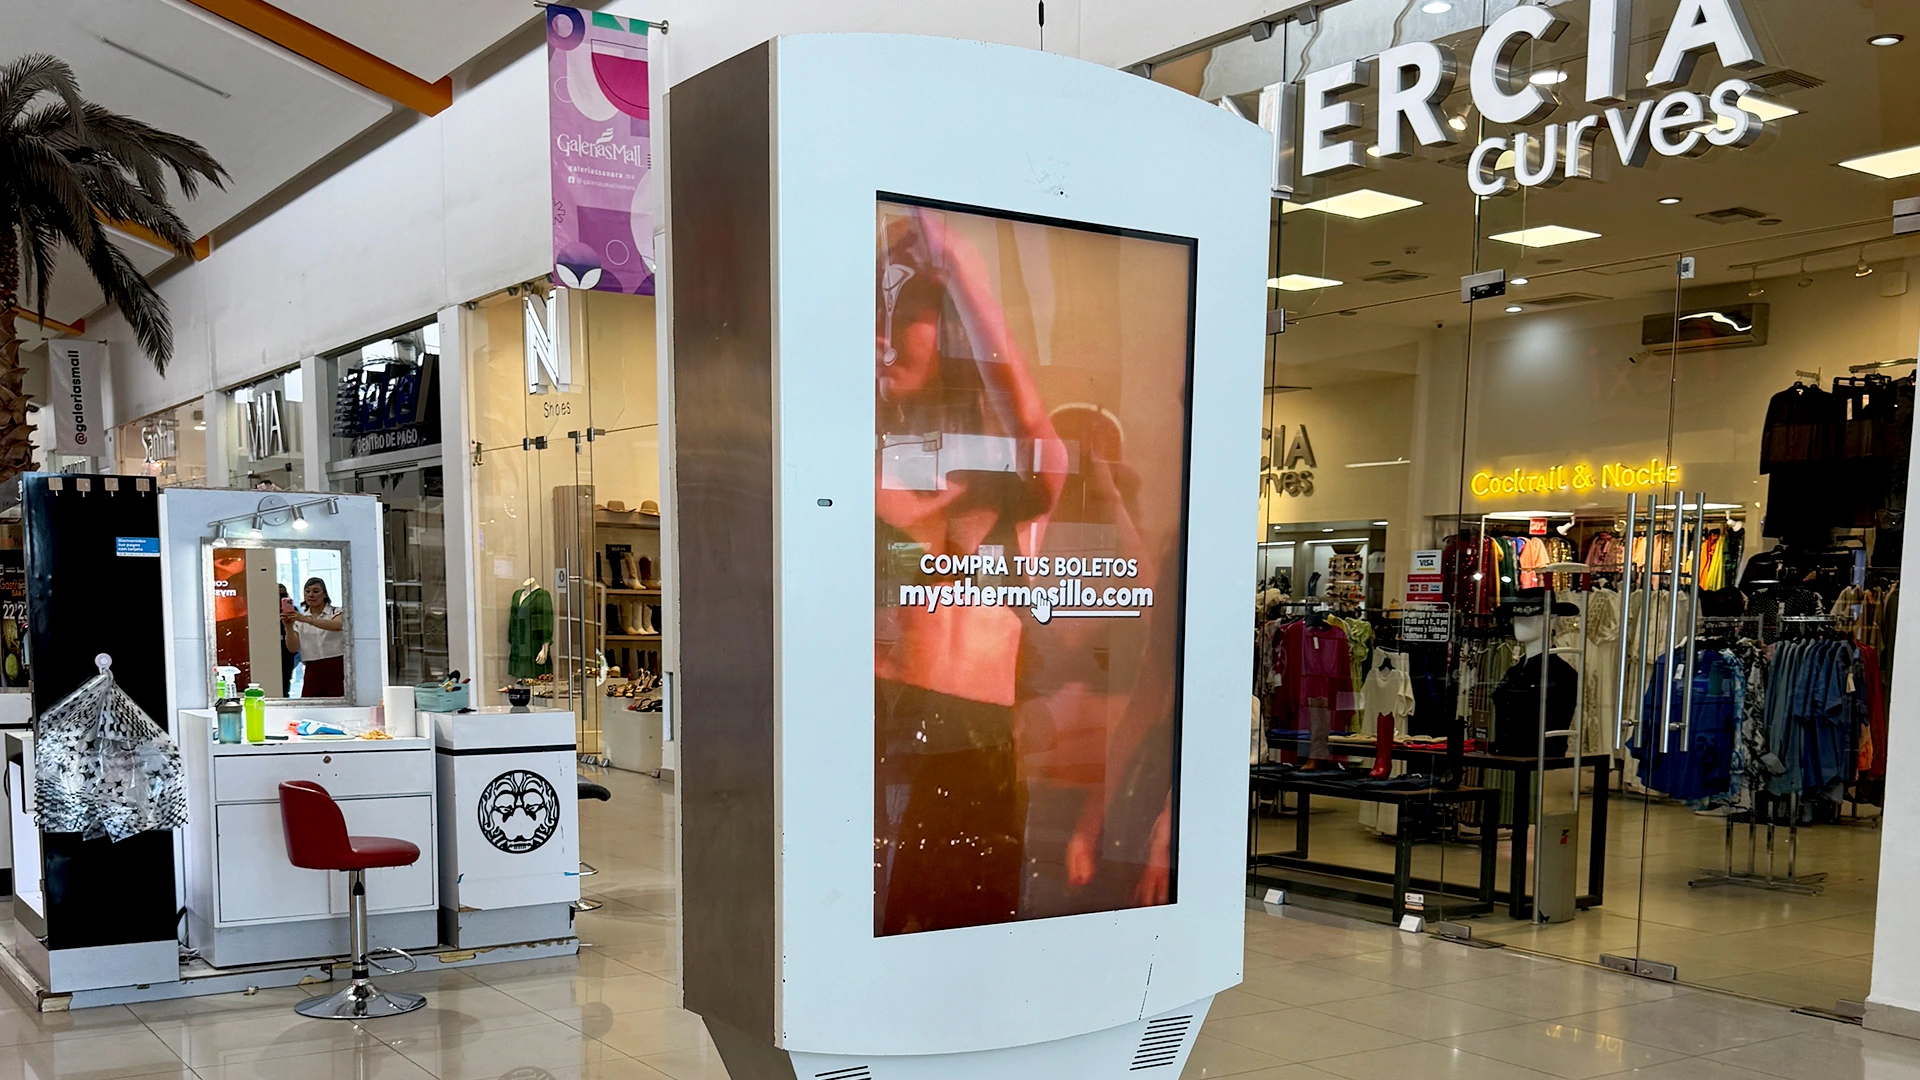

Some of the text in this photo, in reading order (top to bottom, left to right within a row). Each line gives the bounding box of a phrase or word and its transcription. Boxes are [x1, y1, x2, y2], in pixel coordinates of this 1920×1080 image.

[1467, 79, 1760, 197] curves
[68, 350, 87, 445] @galeriasmall
[543, 402, 571, 418] Shoes
[385, 432, 396, 448] DE
[397, 428, 418, 446] PAGO
[1572, 464, 1595, 489] &
[919, 554, 1138, 578] COMPRA TUS BOLETOS
[1418, 559, 1434, 567] VISA
